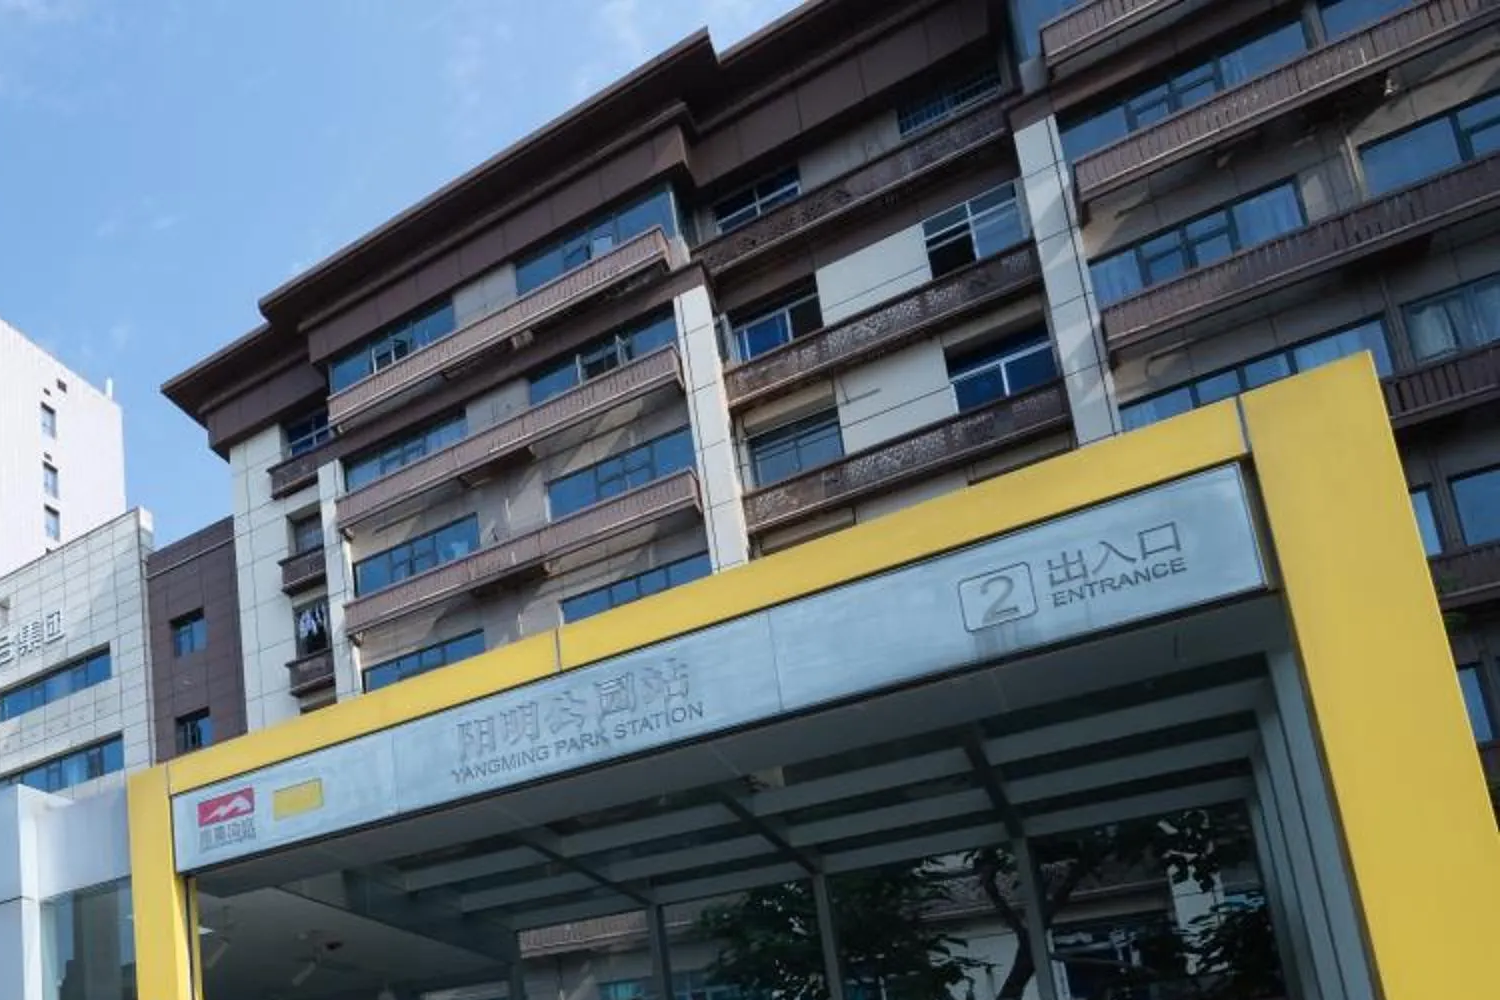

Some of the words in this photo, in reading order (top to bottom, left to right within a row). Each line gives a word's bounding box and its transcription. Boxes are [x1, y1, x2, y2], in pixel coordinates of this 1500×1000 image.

[1047, 521, 1182, 587] 出入口
[1051, 556, 1188, 608] ENTRANCE
[979, 574, 1020, 625] 2
[451, 746, 549, 784] YANGMING
[554, 730, 611, 757] PARK
[613, 701, 705, 740] STATION
[456, 656, 690, 763] 阳明公园站
